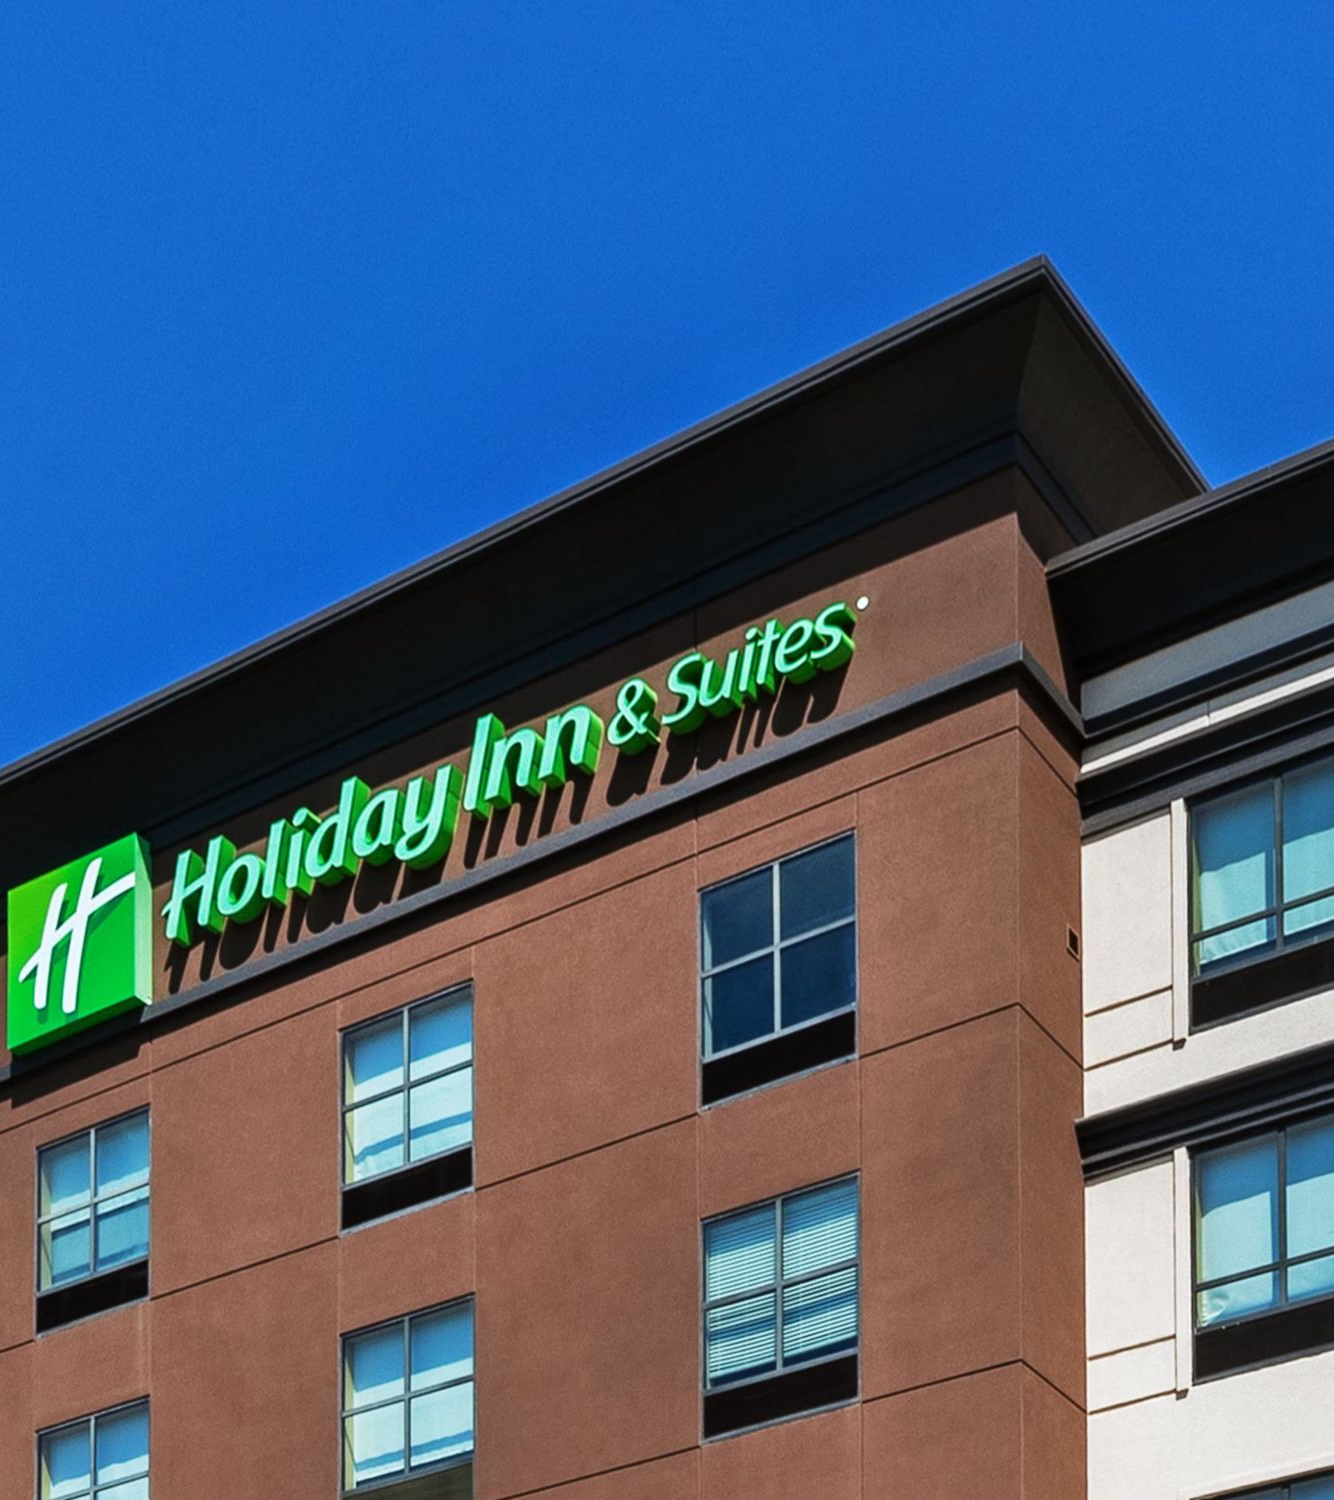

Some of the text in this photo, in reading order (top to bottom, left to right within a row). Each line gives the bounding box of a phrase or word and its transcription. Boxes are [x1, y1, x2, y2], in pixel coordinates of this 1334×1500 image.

[161, 602, 855, 945] Holiday Inn & Suites
